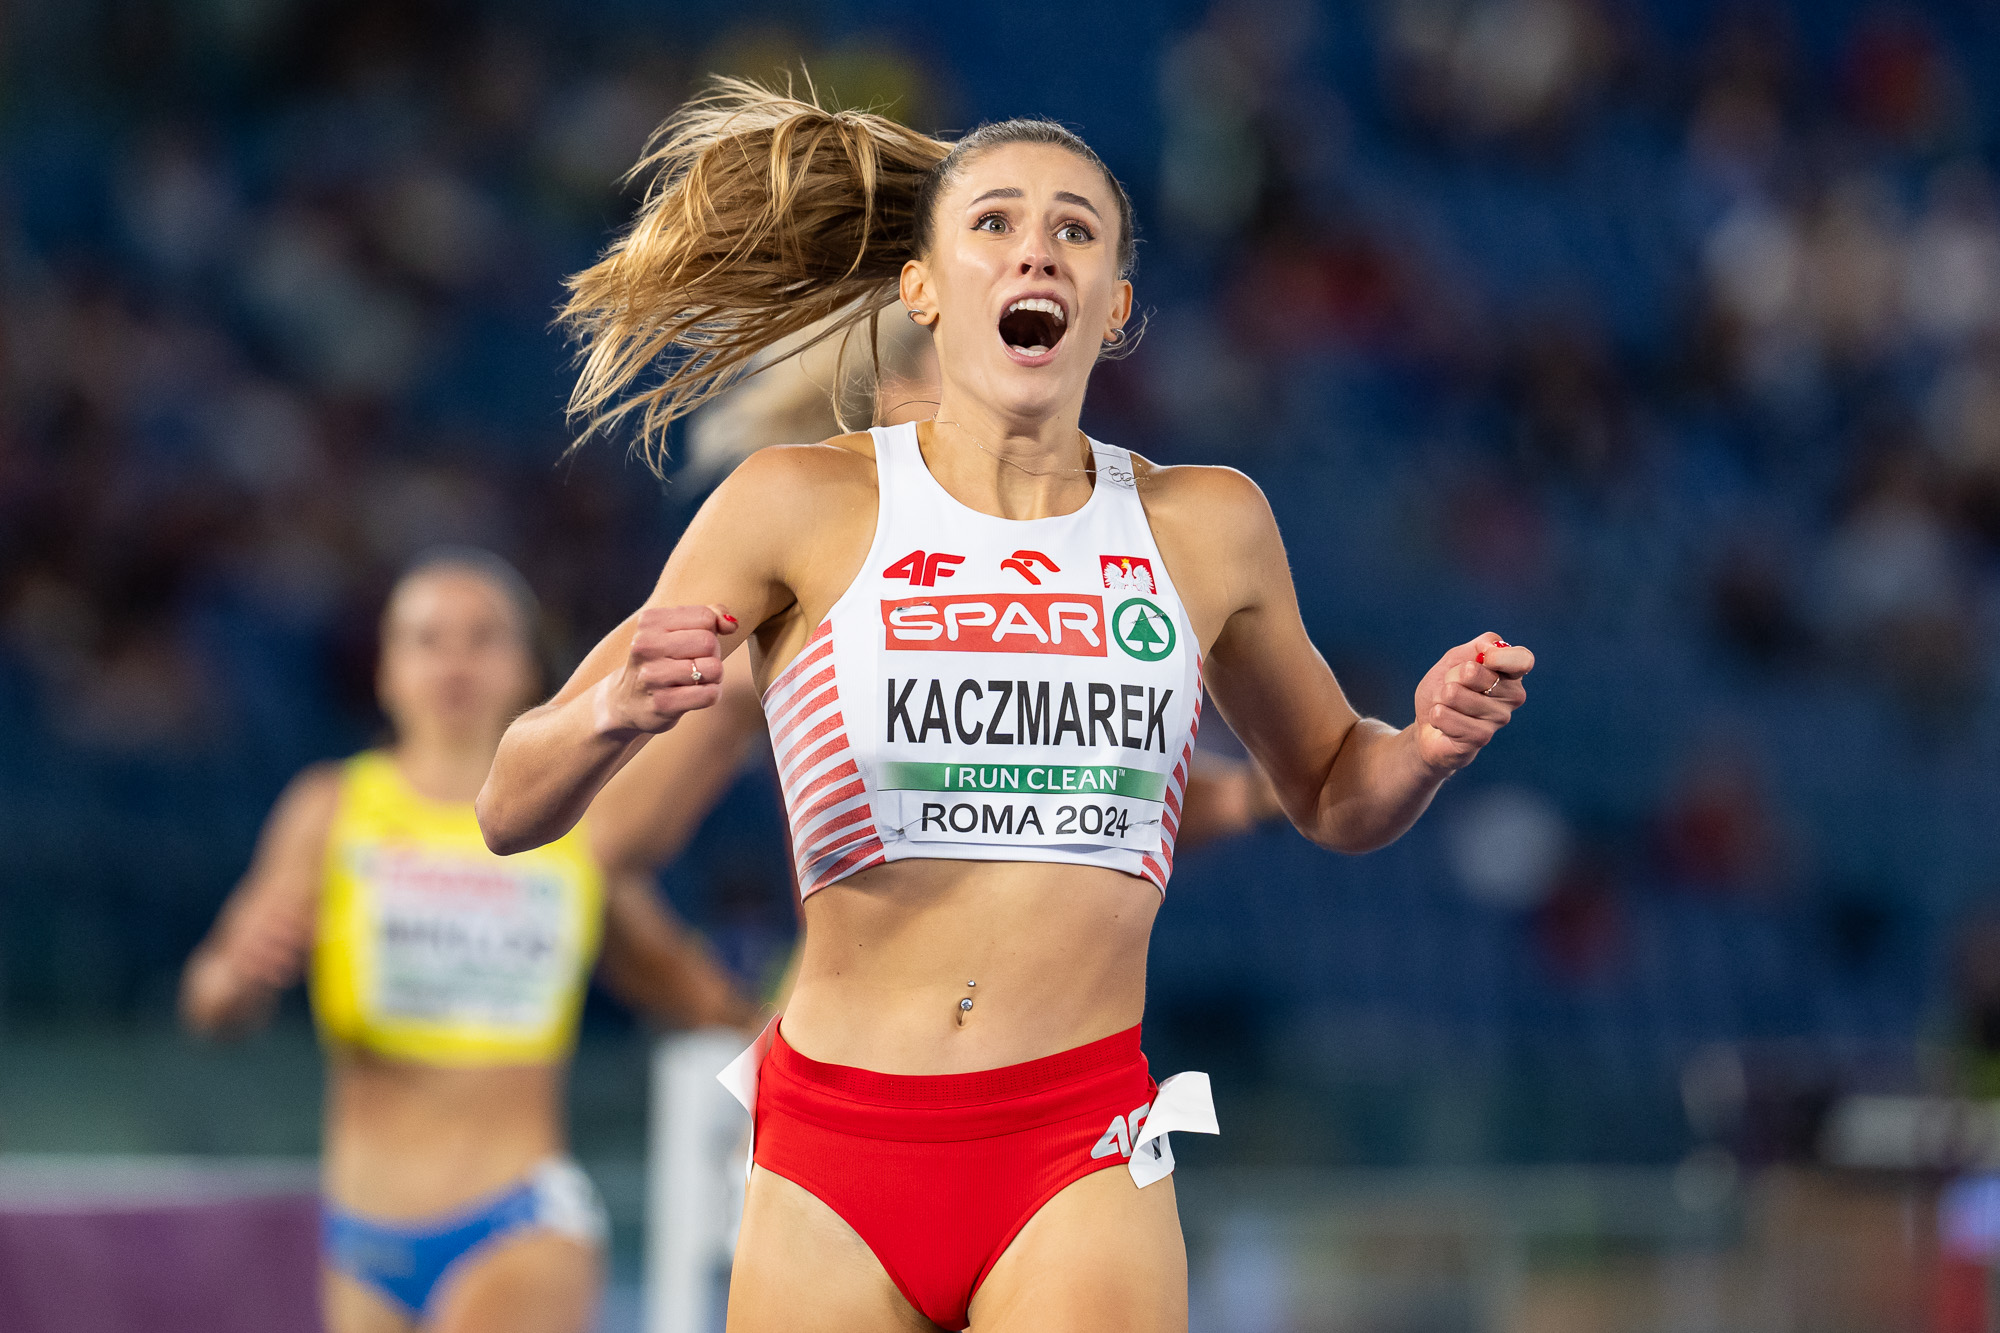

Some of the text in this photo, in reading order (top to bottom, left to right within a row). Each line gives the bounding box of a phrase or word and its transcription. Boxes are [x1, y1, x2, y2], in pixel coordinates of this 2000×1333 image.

[882, 550, 965, 587] 4F
[889, 602, 1101, 647] SPAR
[887, 678, 1174, 754] KACZMAREK
[944, 767, 951, 788] I
[958, 767, 1024, 789] RUN
[921, 803, 1129, 839] ROMA 2024
